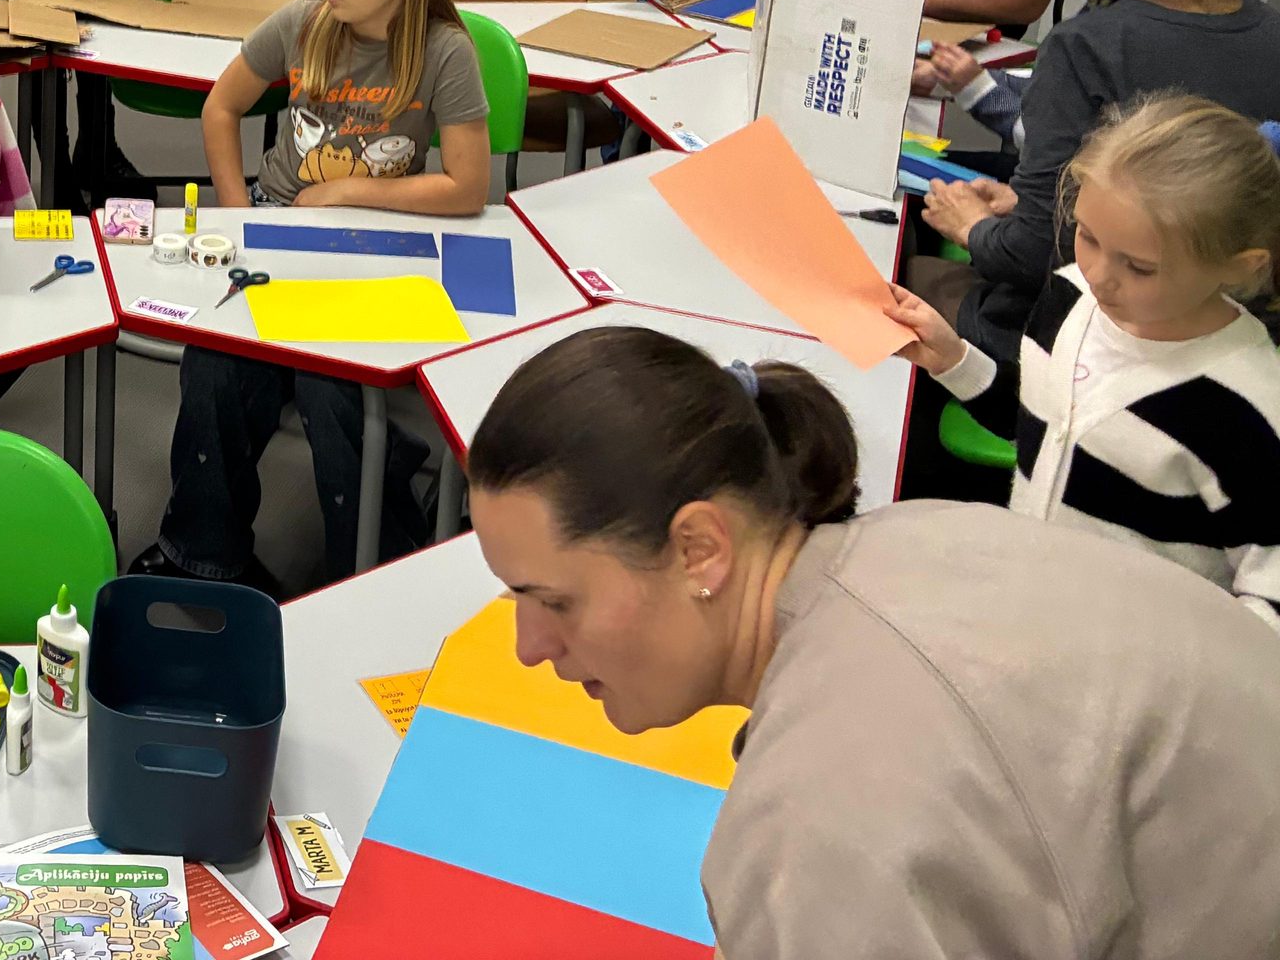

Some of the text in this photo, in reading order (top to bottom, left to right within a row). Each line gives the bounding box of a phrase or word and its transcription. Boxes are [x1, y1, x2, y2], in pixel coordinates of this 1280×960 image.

[813, 32, 836, 112] MADE WITH
[826, 32, 852, 117] RESPECT
[19, 868, 164, 883] Aplikāciju papīrs
[298, 825, 333, 874] MARTA M
